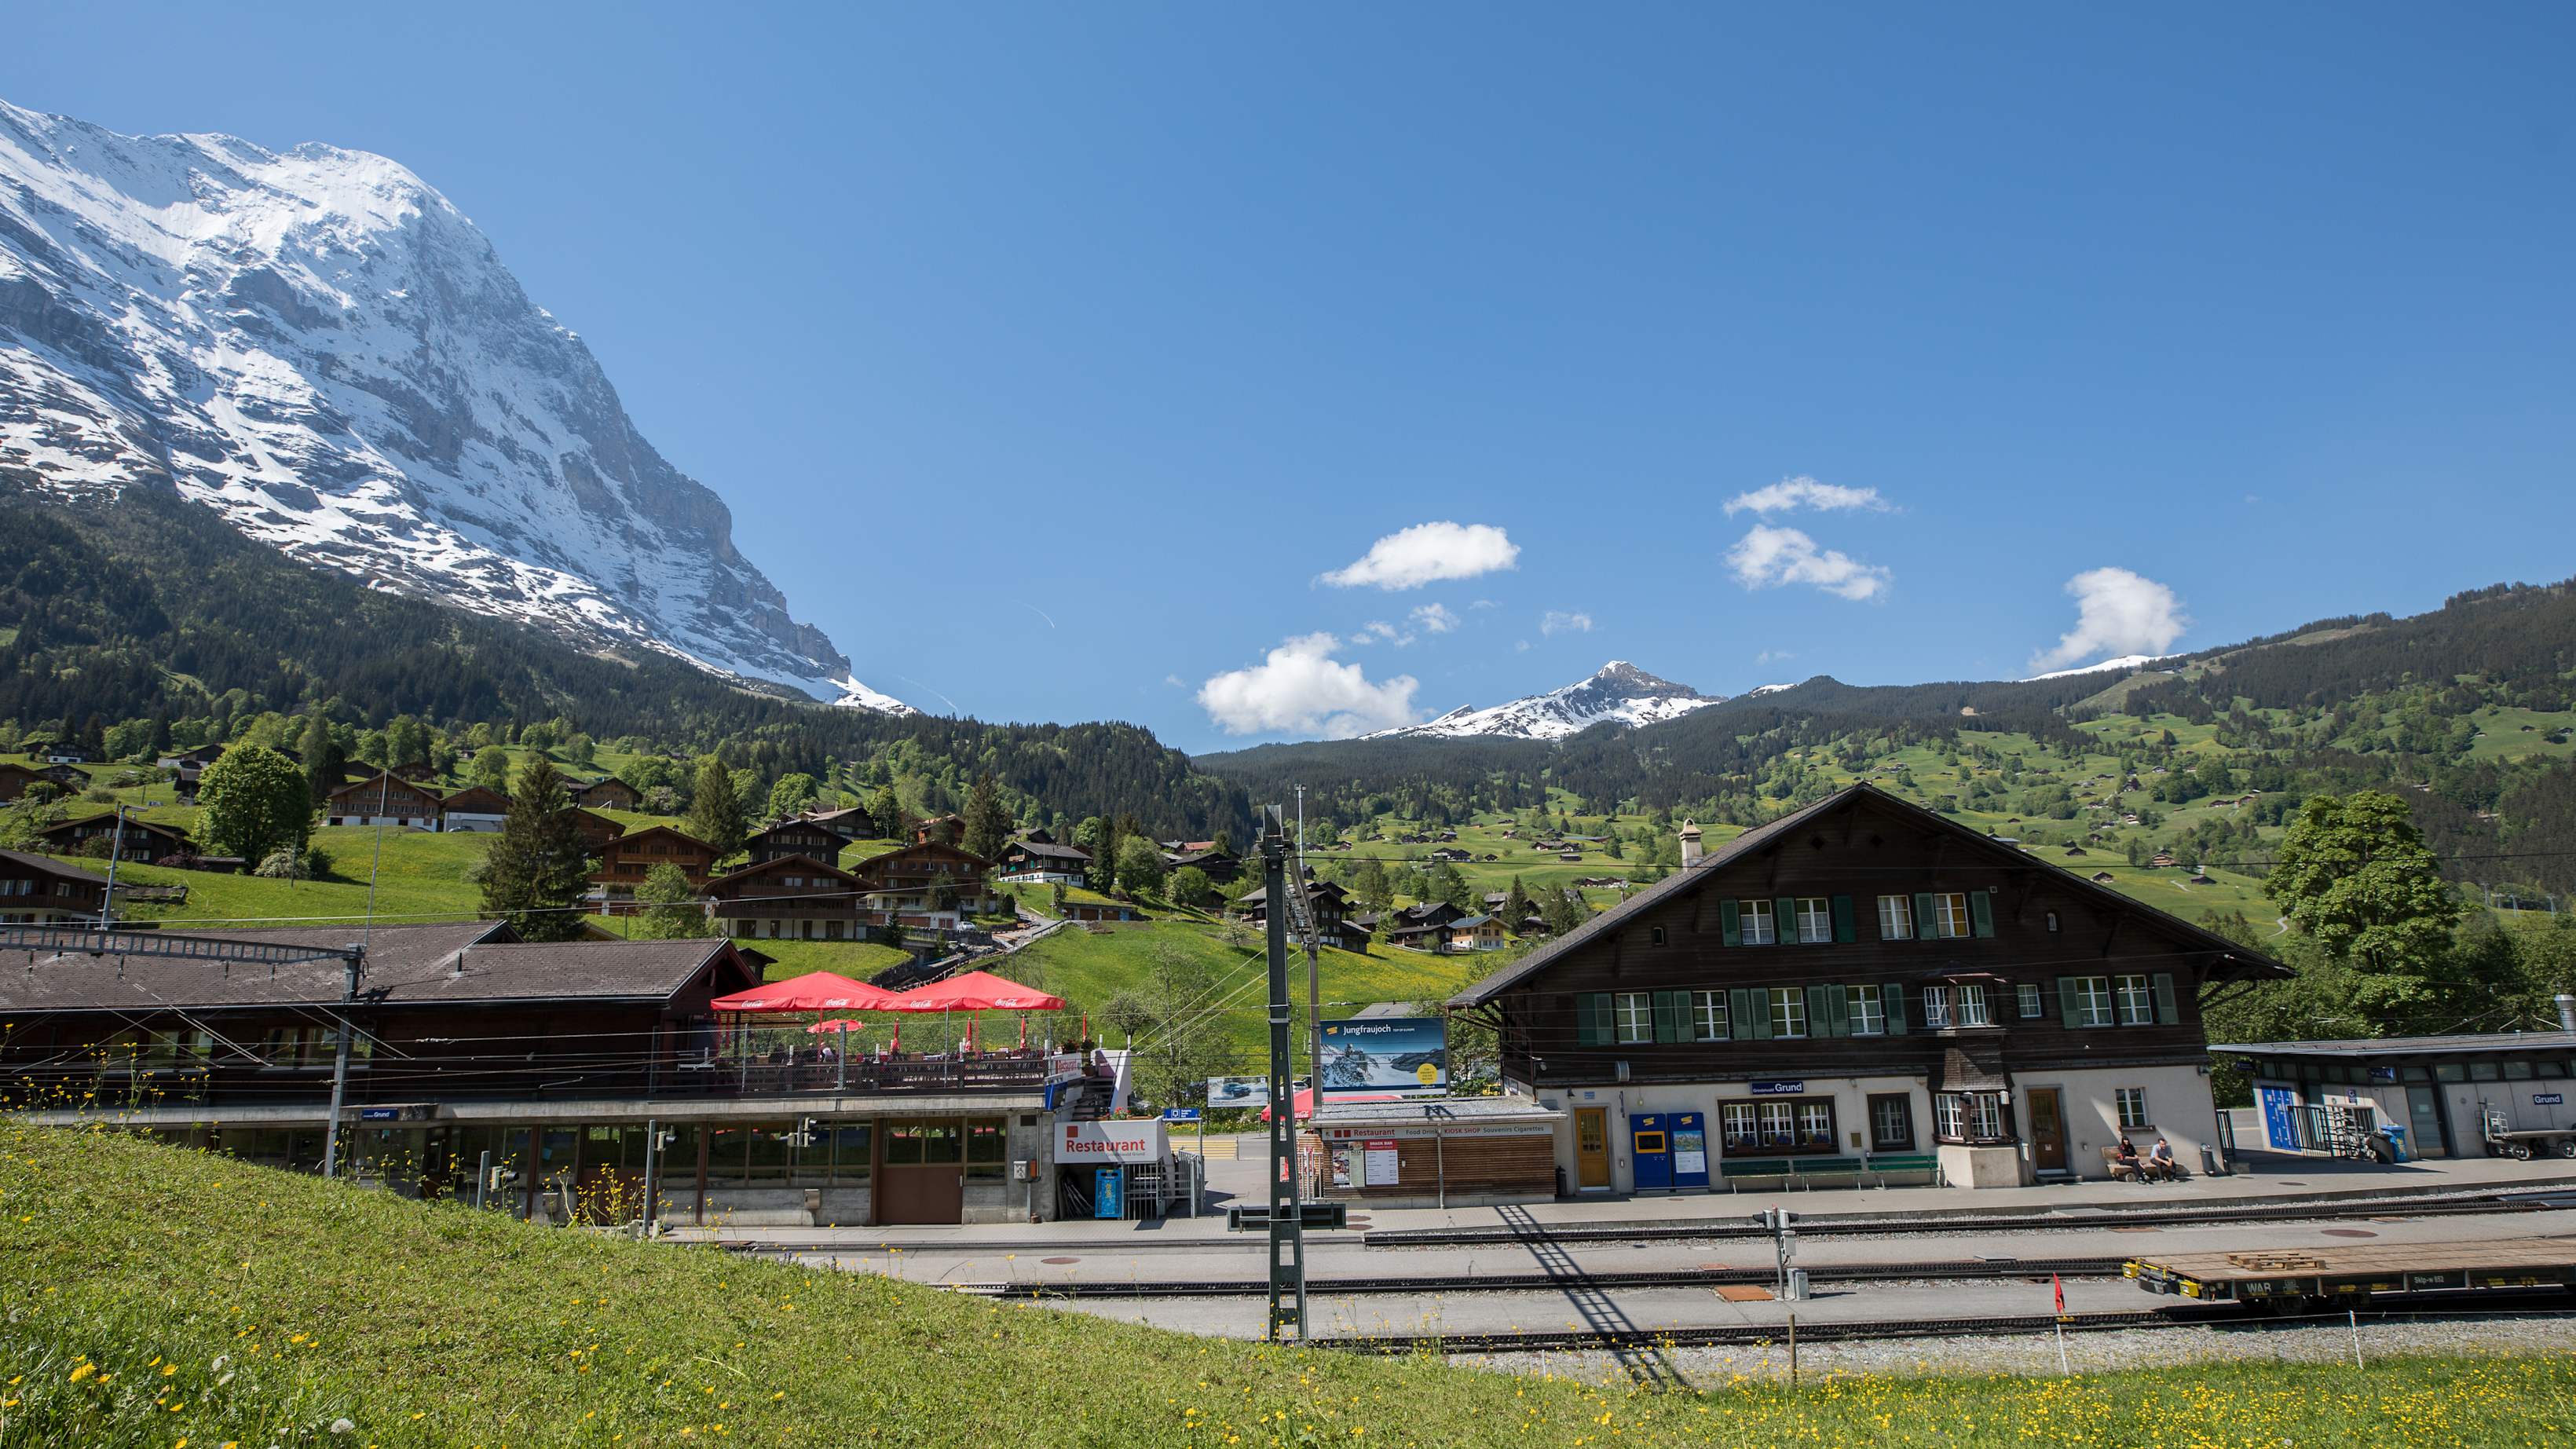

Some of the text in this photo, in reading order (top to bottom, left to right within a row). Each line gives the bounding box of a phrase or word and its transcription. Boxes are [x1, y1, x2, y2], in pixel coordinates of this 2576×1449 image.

[1343, 1024, 1392, 1036] Jungfraujoch
[1775, 1083, 1802, 1092] Grund
[1066, 1139, 1146, 1153] Restaurant
